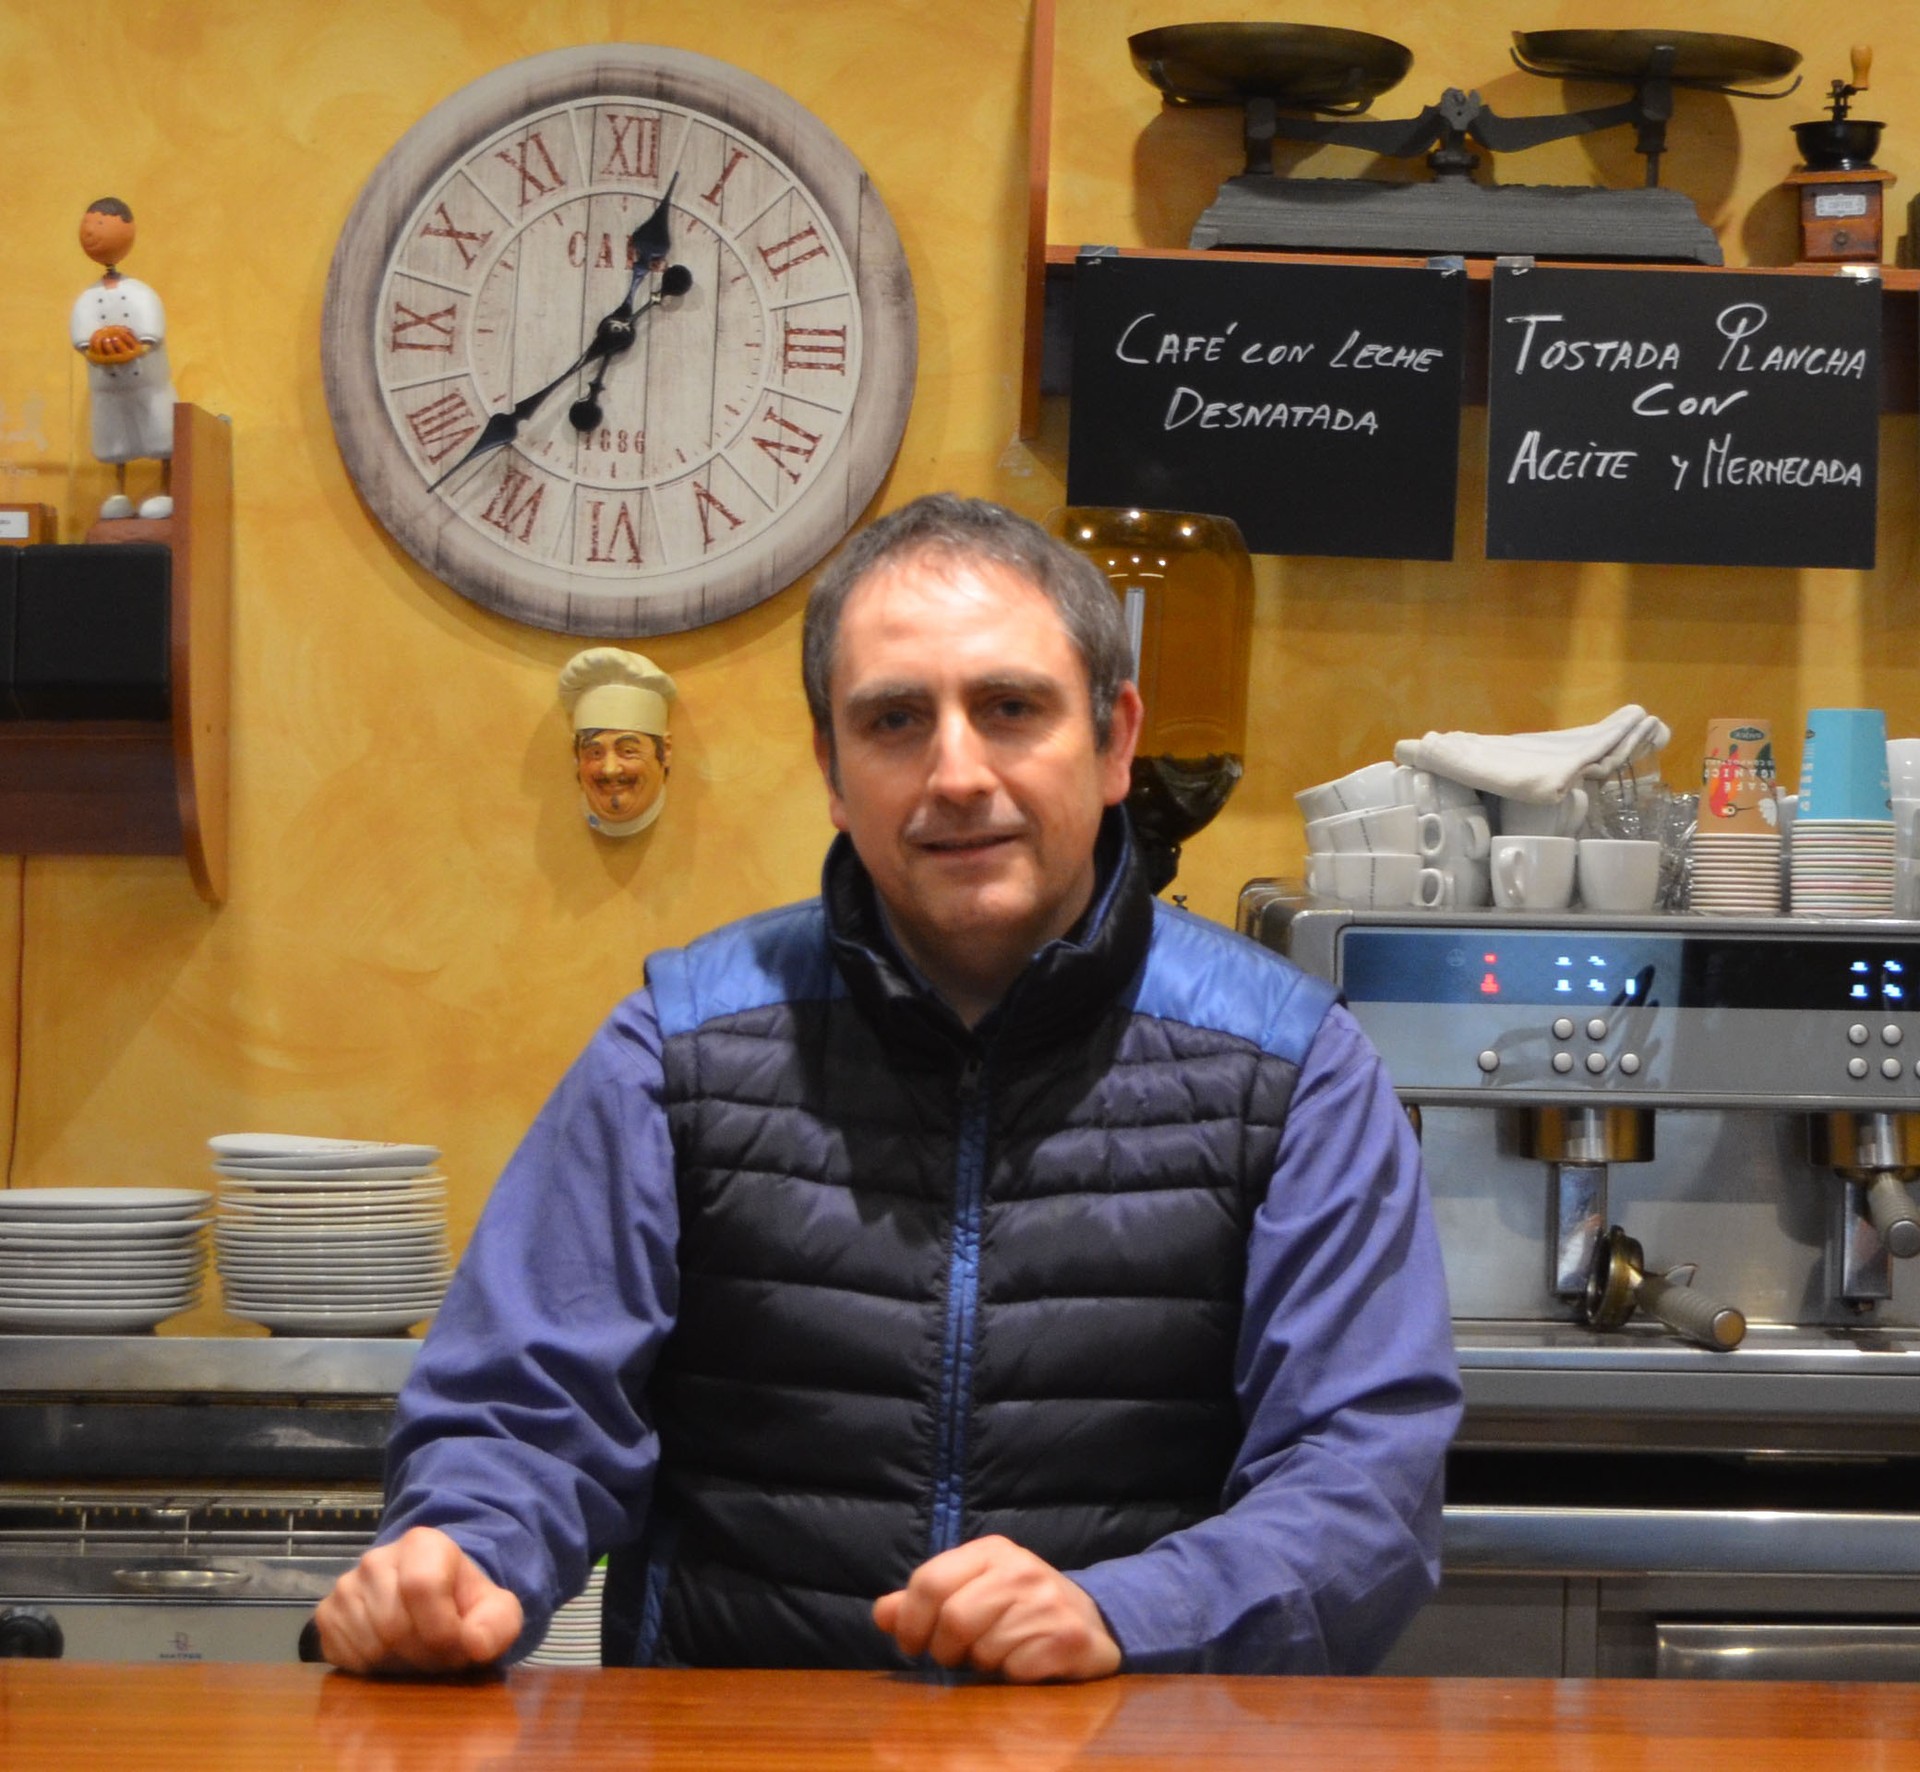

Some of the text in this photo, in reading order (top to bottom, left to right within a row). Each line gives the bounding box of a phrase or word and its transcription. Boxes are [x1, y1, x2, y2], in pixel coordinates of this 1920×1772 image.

[495, 133, 566, 208] XI
[600, 114, 660, 179] XII
[700, 147, 750, 207] I
[420, 203, 494, 270] X
[757, 222, 829, 282] II
[391, 301, 457, 354] IX
[783, 321, 847, 375] III
[1116, 313, 1443, 372] CAFÉ CON LECHE
[1506, 302, 1867, 379] TOSTADA PLANCHA
[406, 387, 482, 466] VIII
[1164, 386, 1378, 435] DESNATADA
[1632, 383, 1749, 416] CON
[751, 407, 822, 485] IV
[1507, 430, 1638, 484] ACEITE
[1703, 433, 1861, 488] MERMELADA
[480, 467, 550, 546] VII
[586, 501, 644, 564] VI
[692, 480, 746, 546] V
